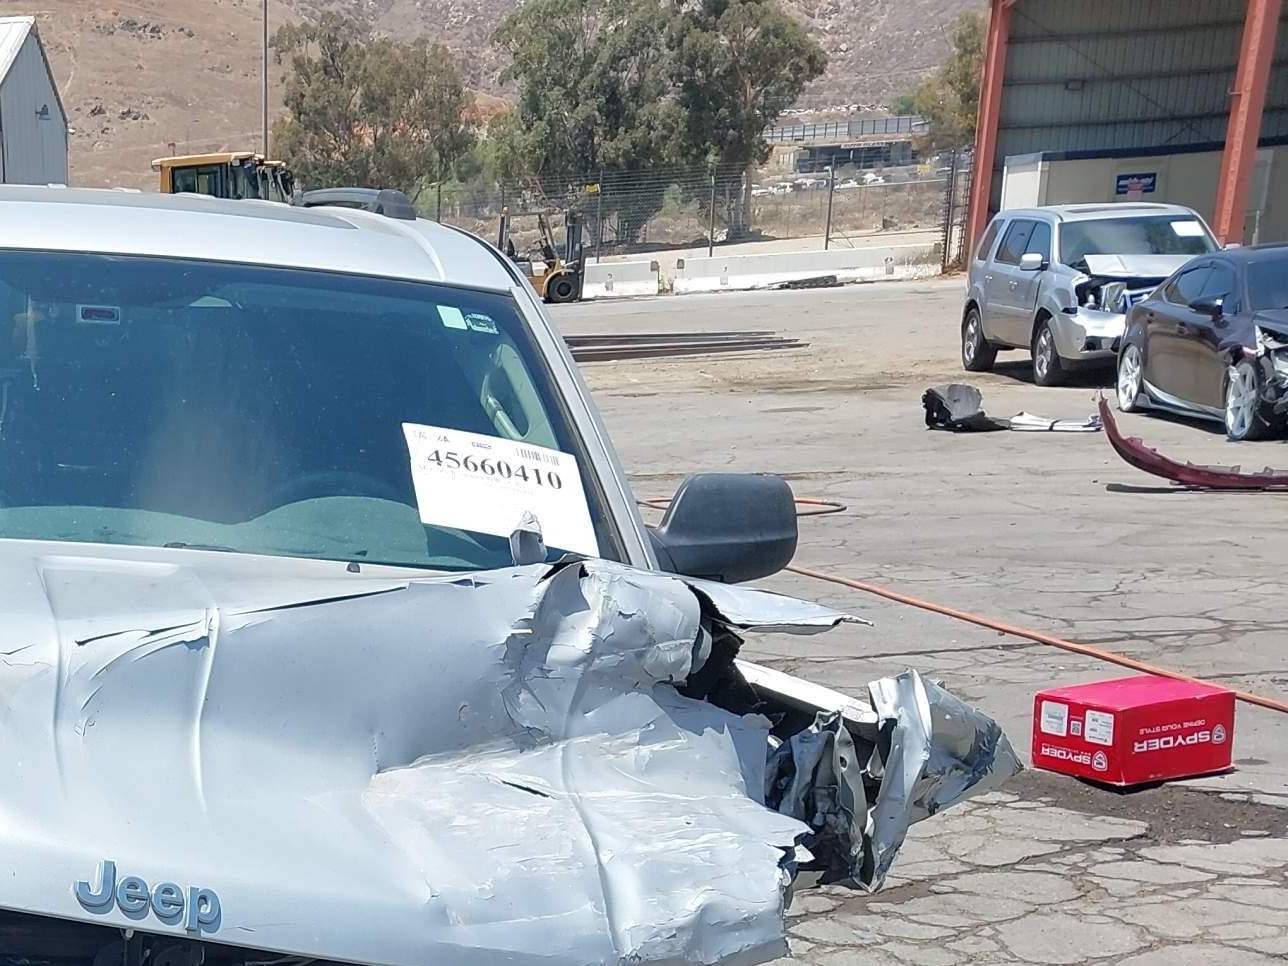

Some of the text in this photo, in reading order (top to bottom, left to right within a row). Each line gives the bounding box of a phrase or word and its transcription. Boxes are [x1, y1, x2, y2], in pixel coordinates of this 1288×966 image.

[427, 450, 562, 489] 45660410
[1139, 726, 1161, 735] STYLE
[1162, 723, 1182, 732] YOUR
[1134, 731, 1210, 752] SPYDER
[1041, 745, 1091, 764] SPYDER
[74, 859, 222, 938] Jeep
